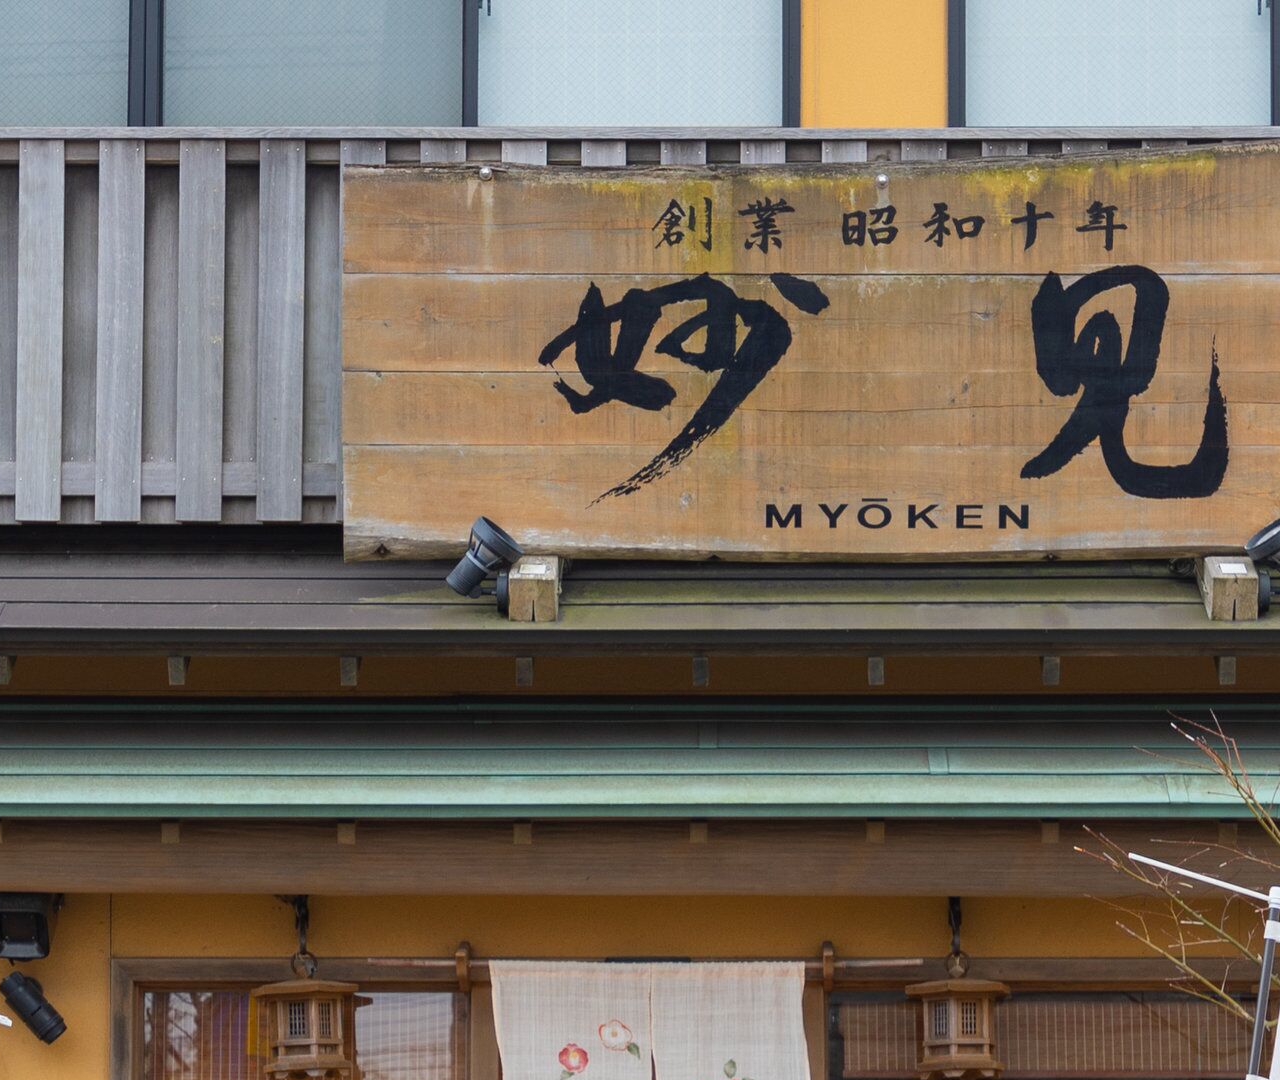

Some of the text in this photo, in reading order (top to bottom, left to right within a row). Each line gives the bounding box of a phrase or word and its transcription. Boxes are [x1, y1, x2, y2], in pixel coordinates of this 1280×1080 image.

[651, 196, 1129, 252] 創業 昭和十年
[538, 264, 1229, 507] 妙見
[764, 498, 1031, 530] MYŌKEN
